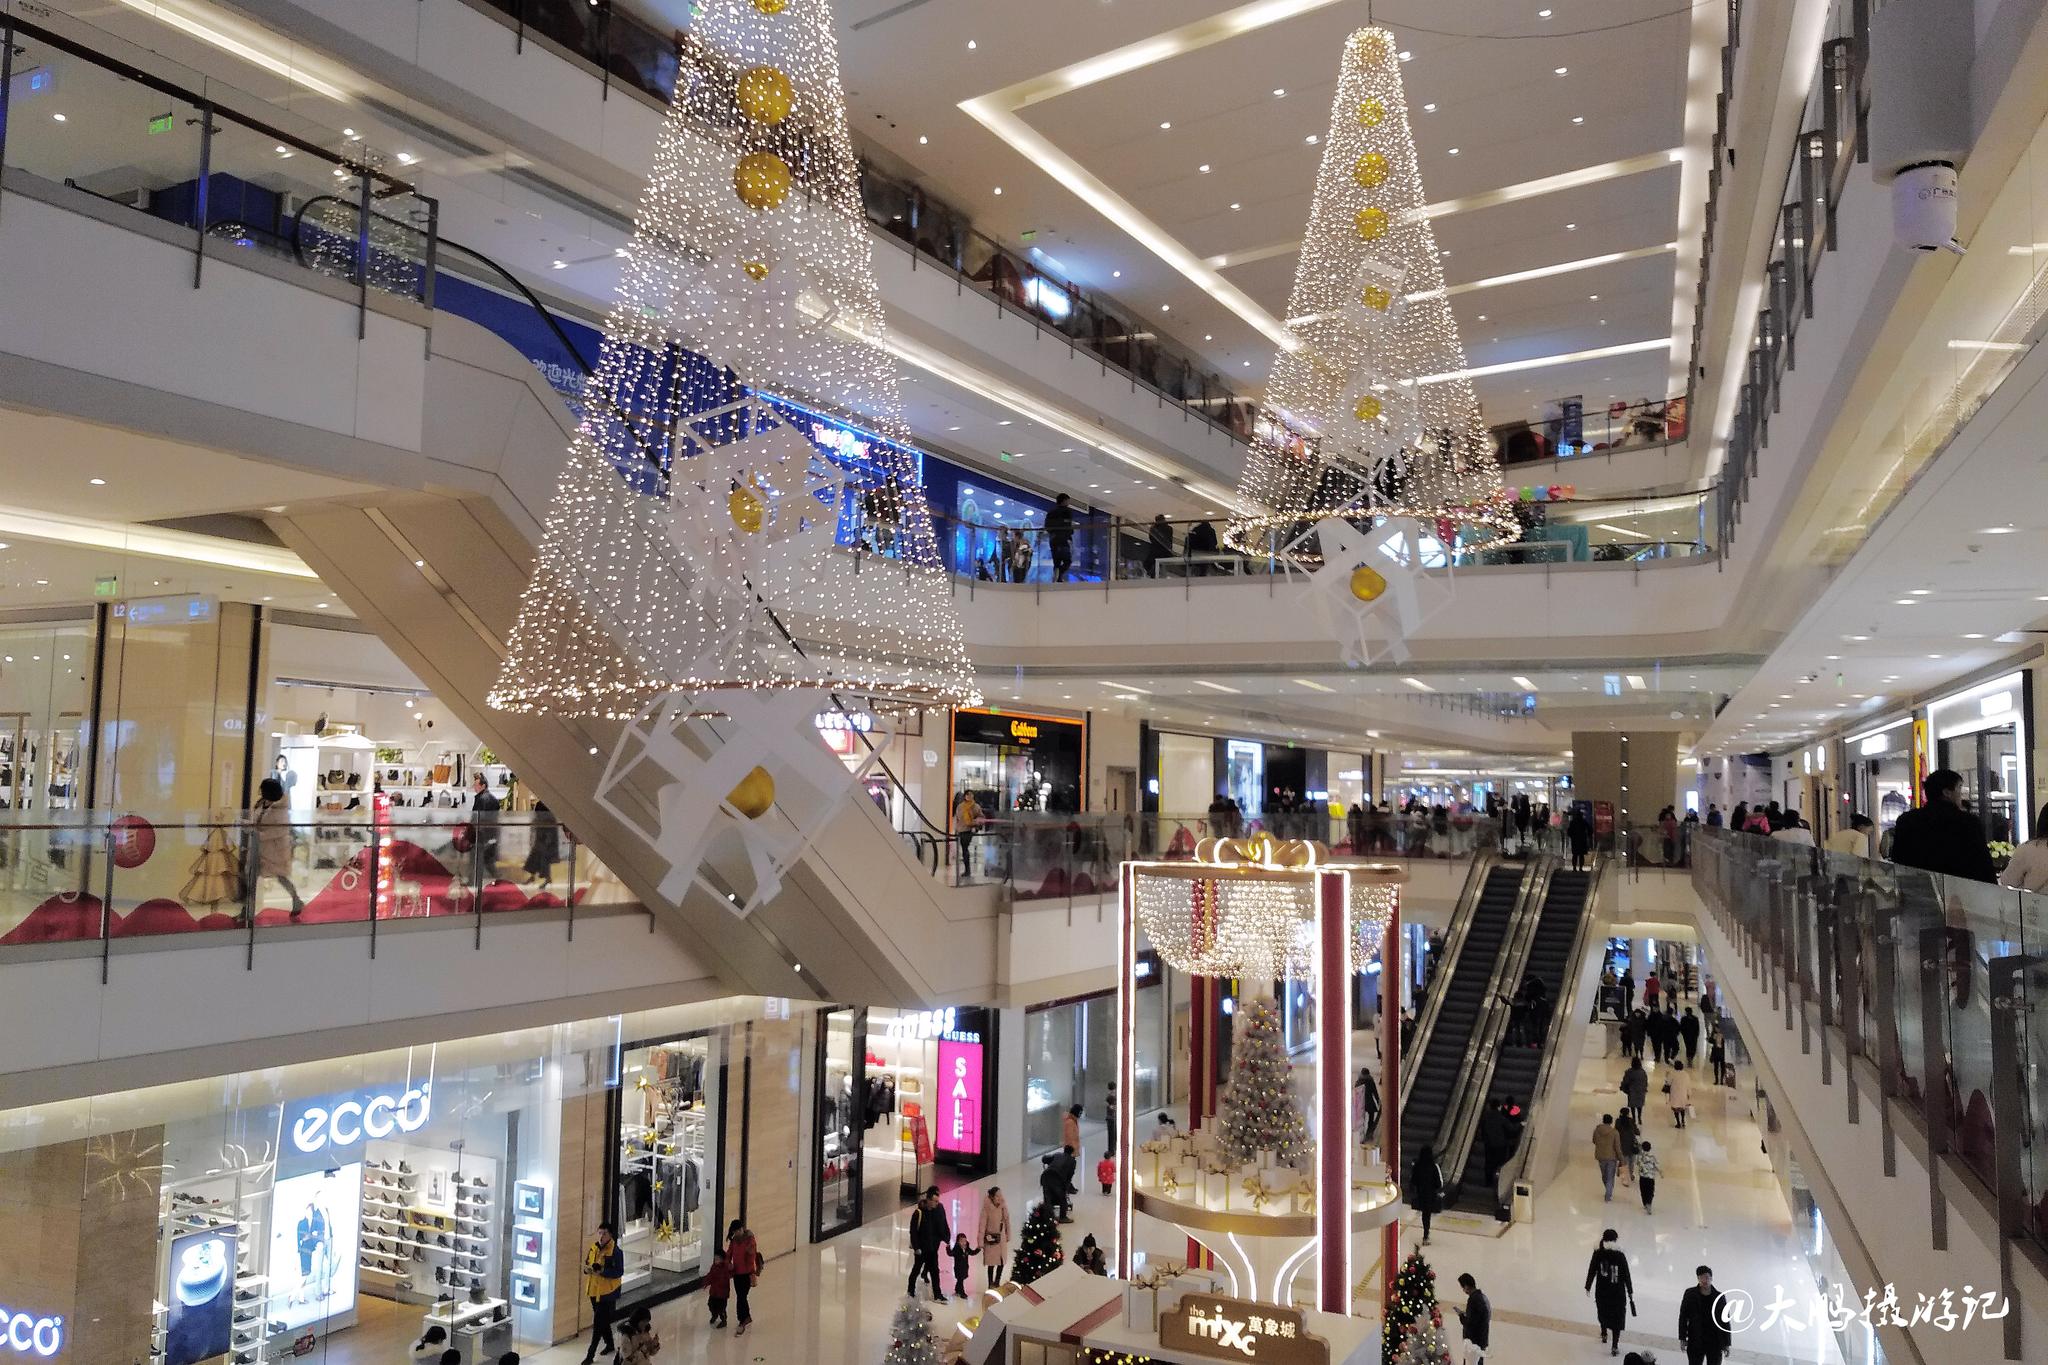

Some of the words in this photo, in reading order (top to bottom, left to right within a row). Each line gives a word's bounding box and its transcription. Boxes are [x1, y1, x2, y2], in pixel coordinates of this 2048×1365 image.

[943, 1031, 980, 1043] GUESS
[952, 1057, 968, 1139] SALE
[293, 1088, 429, 1152] ecco
[1190, 1304, 1205, 1317] the
[1248, 1315, 1296, 1339] 萬象城
